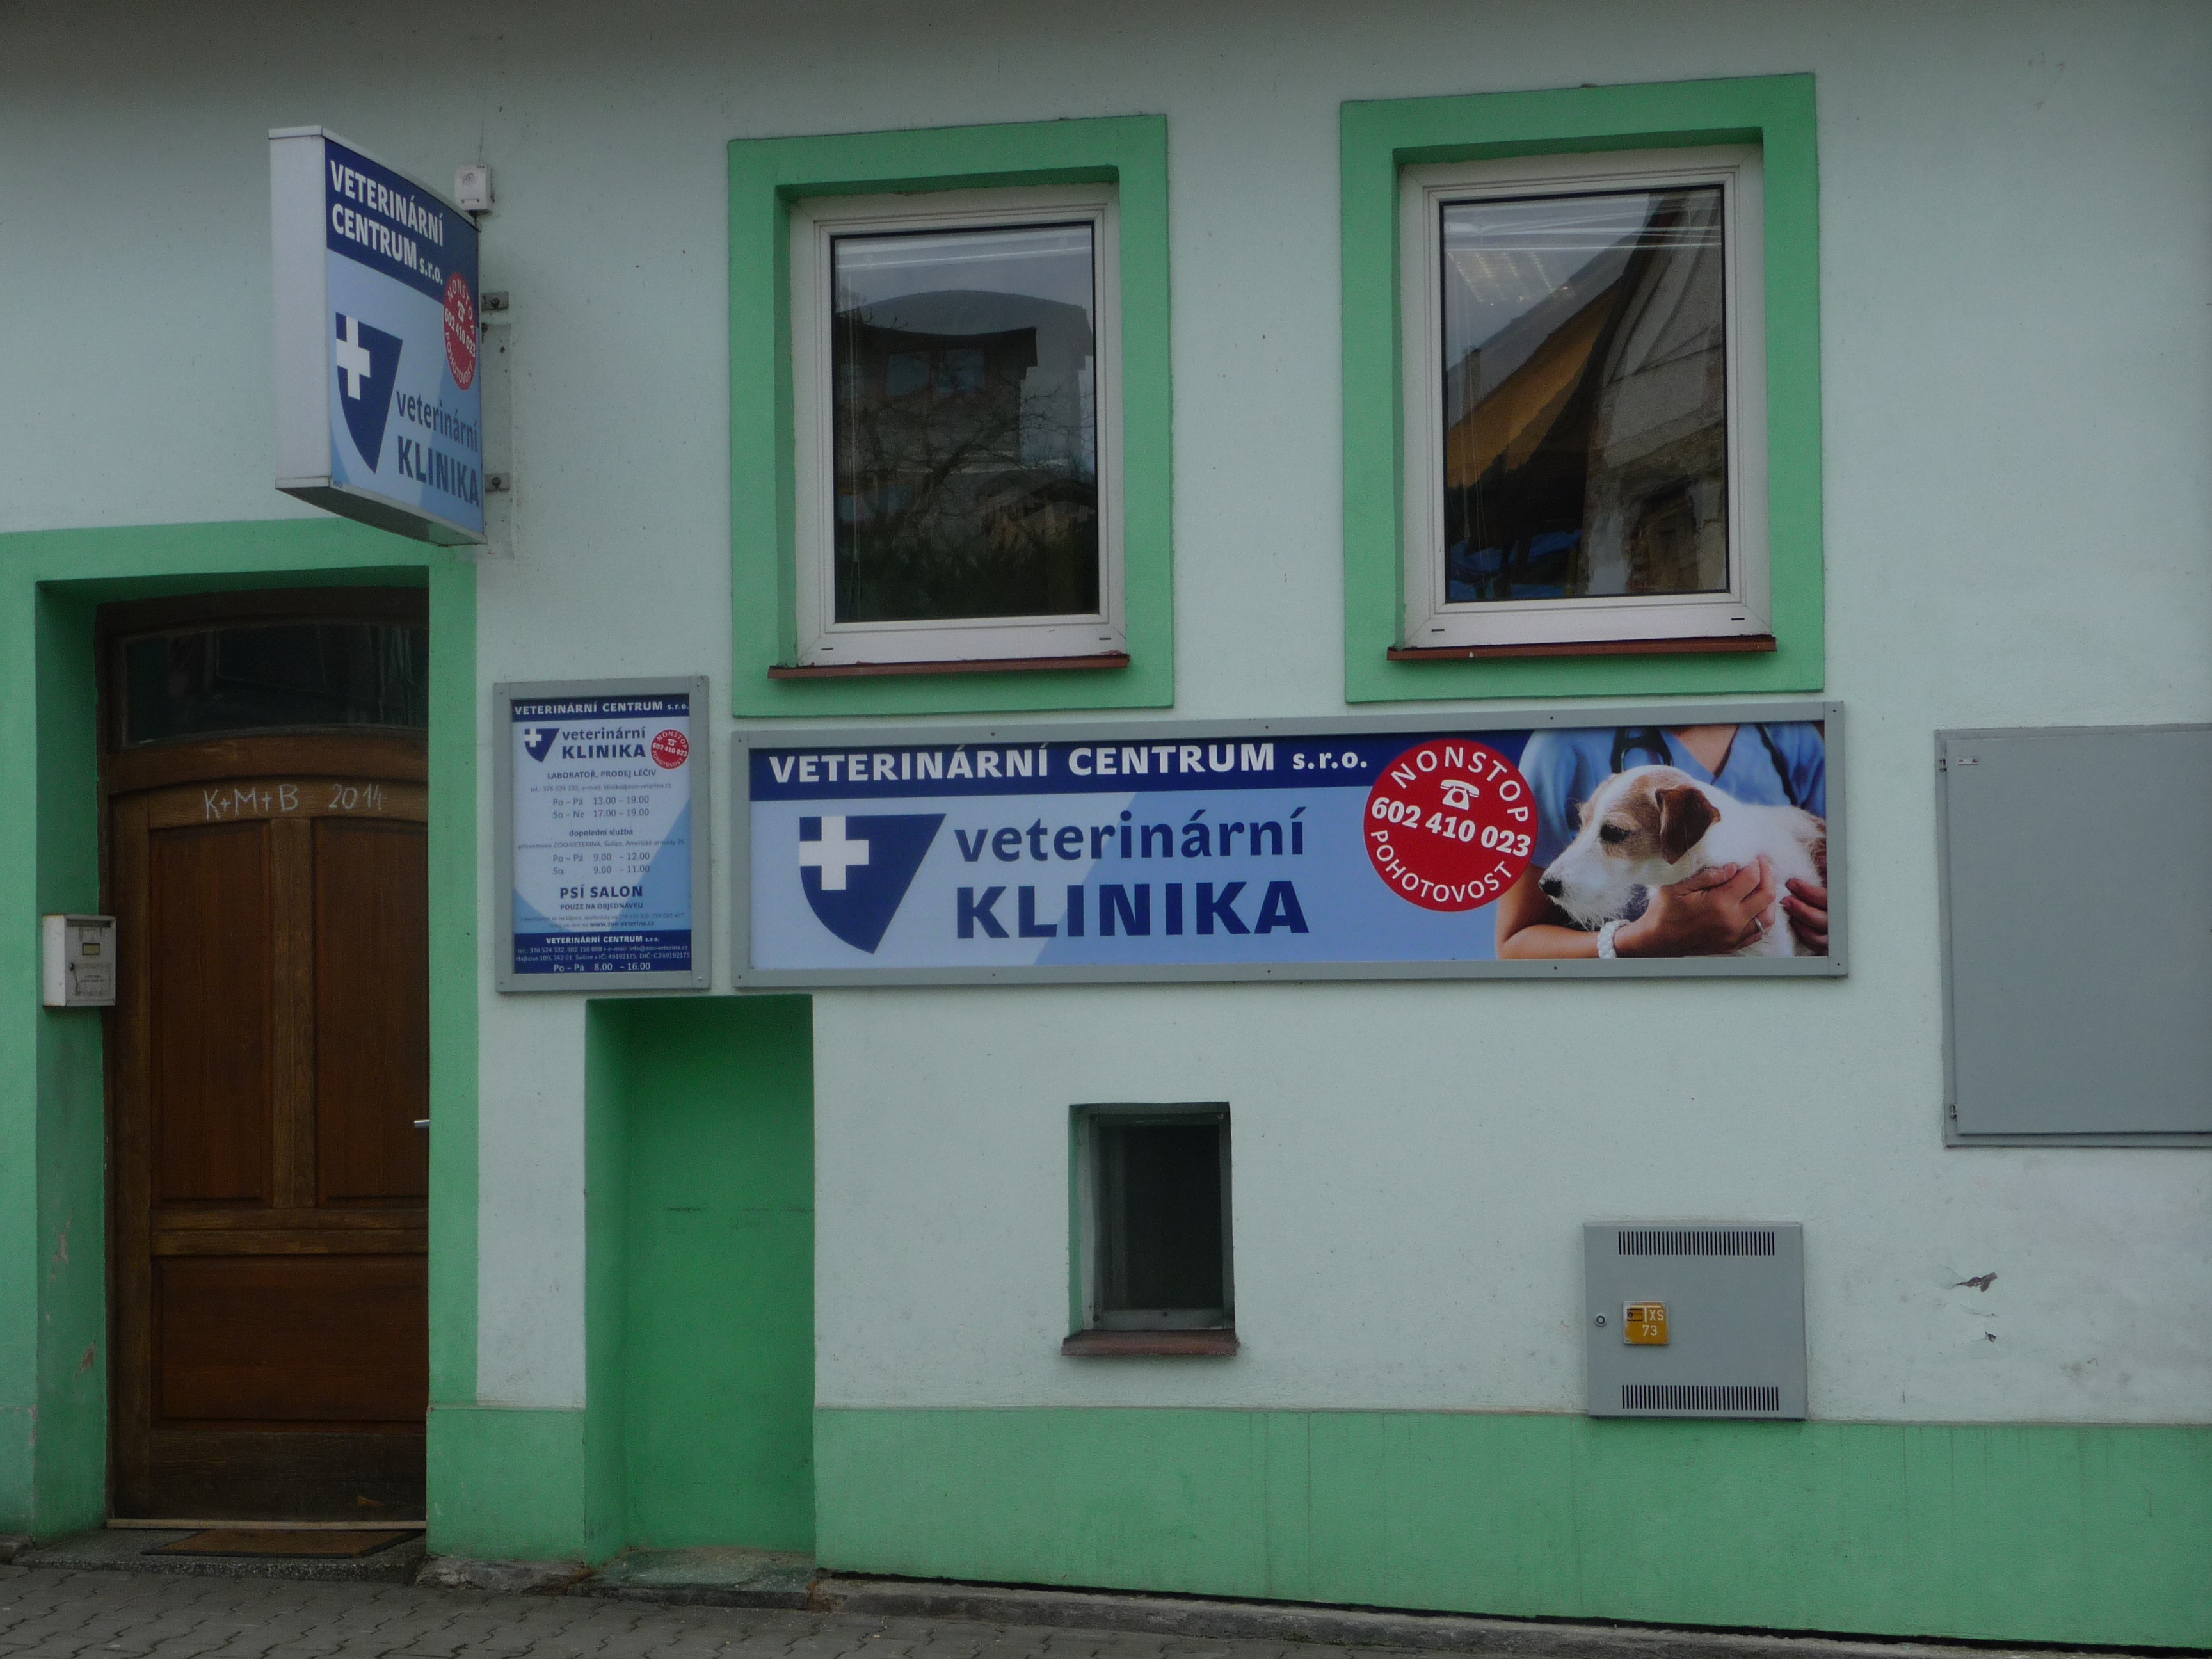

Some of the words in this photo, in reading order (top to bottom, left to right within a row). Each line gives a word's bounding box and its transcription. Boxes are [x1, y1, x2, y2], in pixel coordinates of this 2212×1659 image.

[330, 159, 444, 247] VETERINÁRNÍ
[332, 203, 417, 270] CENTRUM
[419, 257, 444, 285] s.r.o.
[447, 278, 475, 335] NONSTOP
[444, 307, 455, 332] 602
[455, 322, 466, 344] 410
[466, 335, 476, 358] 023
[445, 332, 473, 383] POHOTOVOST
[396, 390, 477, 453] veterinární
[397, 435, 479, 507] KLINIKA
[514, 701, 598, 716] VETERINÁRNÍ
[602, 701, 663, 712] CENTRUM
[562, 726, 646, 741] veterinární
[657, 730, 687, 749] NONSTOP
[562, 744, 646, 760] KLINIKA
[652, 750, 684, 767] POHOTOVOST
[769, 742, 1050, 784] VETERINÁRNÍ
[1068, 742, 1276, 776] CENTRUM
[1292, 751, 1368, 770] s.r.o.
[600, 770, 632, 779] PRODEJ
[1390, 746, 1529, 824] NONSTOP
[328, 783, 383, 811] 2014
[593, 797, 616, 805] 13.00
[627, 796, 650, 804] 19.00
[552, 810, 563, 819] So
[627, 808, 650, 817] 19.00
[954, 805, 1308, 863] veterinární
[1372, 797, 1422, 828] 602
[1425, 812, 1476, 842] 410
[1481, 826, 1531, 858] 023
[627, 852, 650, 860] 12.00
[1370, 830, 1513, 903] POHOTOVOST
[552, 867, 563, 875] So
[627, 865, 650, 873] 11.00
[559, 884, 584, 899] PSÍ
[590, 885, 643, 898] SALON
[956, 879, 1310, 940] KLINIKA
[546, 935, 600, 944] VETERINÁRNÍ
[574, 963, 584, 972] Pá
[594, 963, 613, 971] 8.00
[627, 962, 651, 970] 16.00
[1642, 1324, 1658, 1336] 73
